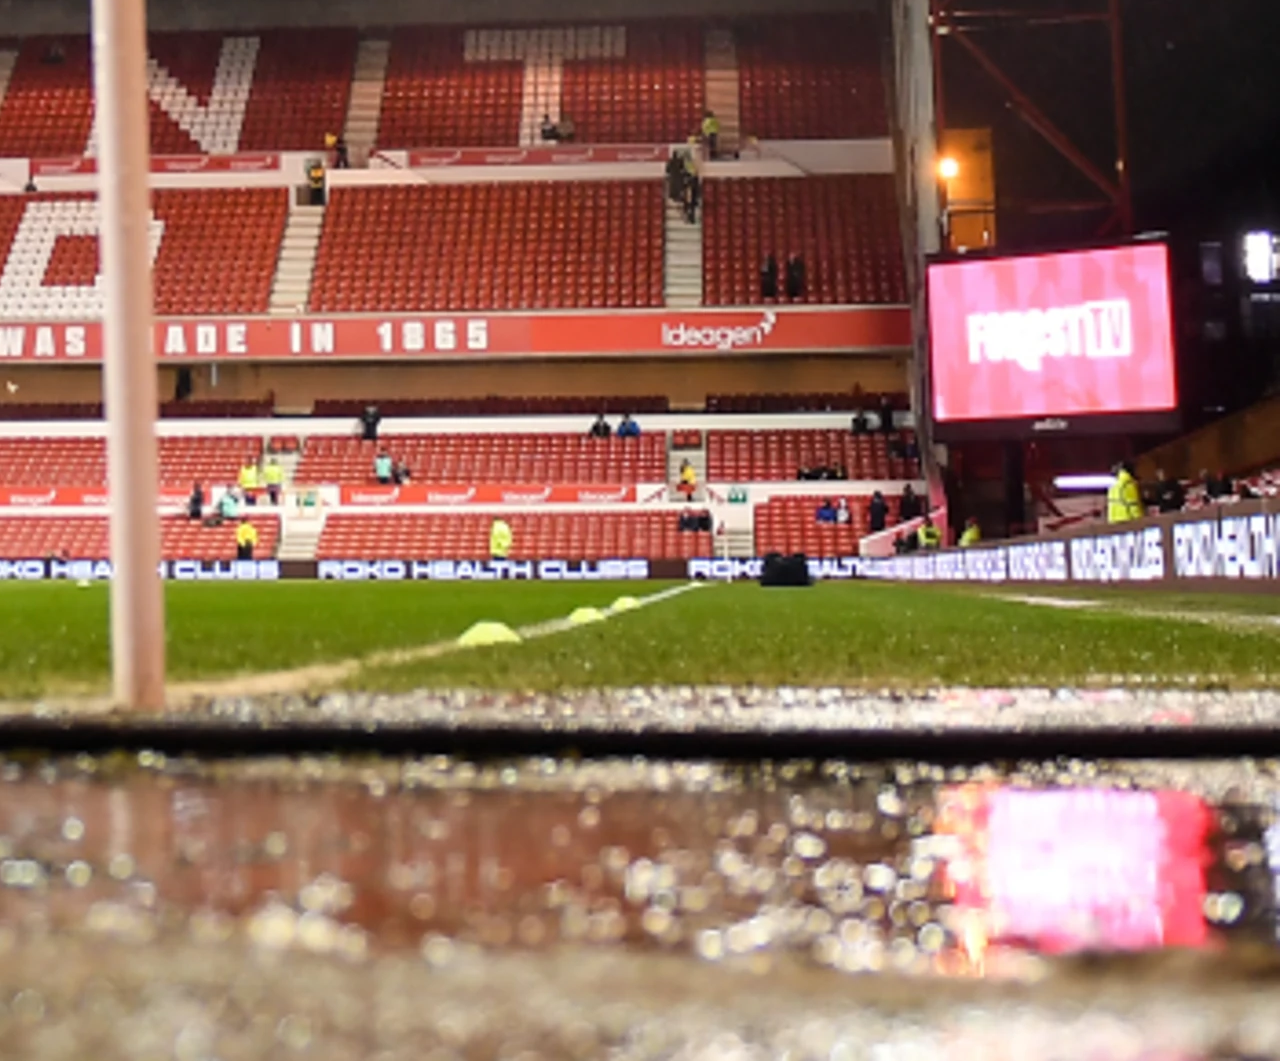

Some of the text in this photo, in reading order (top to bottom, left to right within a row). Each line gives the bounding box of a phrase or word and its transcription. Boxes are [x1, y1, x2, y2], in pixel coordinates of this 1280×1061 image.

[163, 322, 248, 355] ADE
[290, 321, 335, 353] IN
[376, 318, 489, 352] 1865
[660, 322, 762, 350] Ideagen
[173, 560, 279, 580] CLUBS
[318, 560, 648, 580] ROKO HEALTH CLUBS
